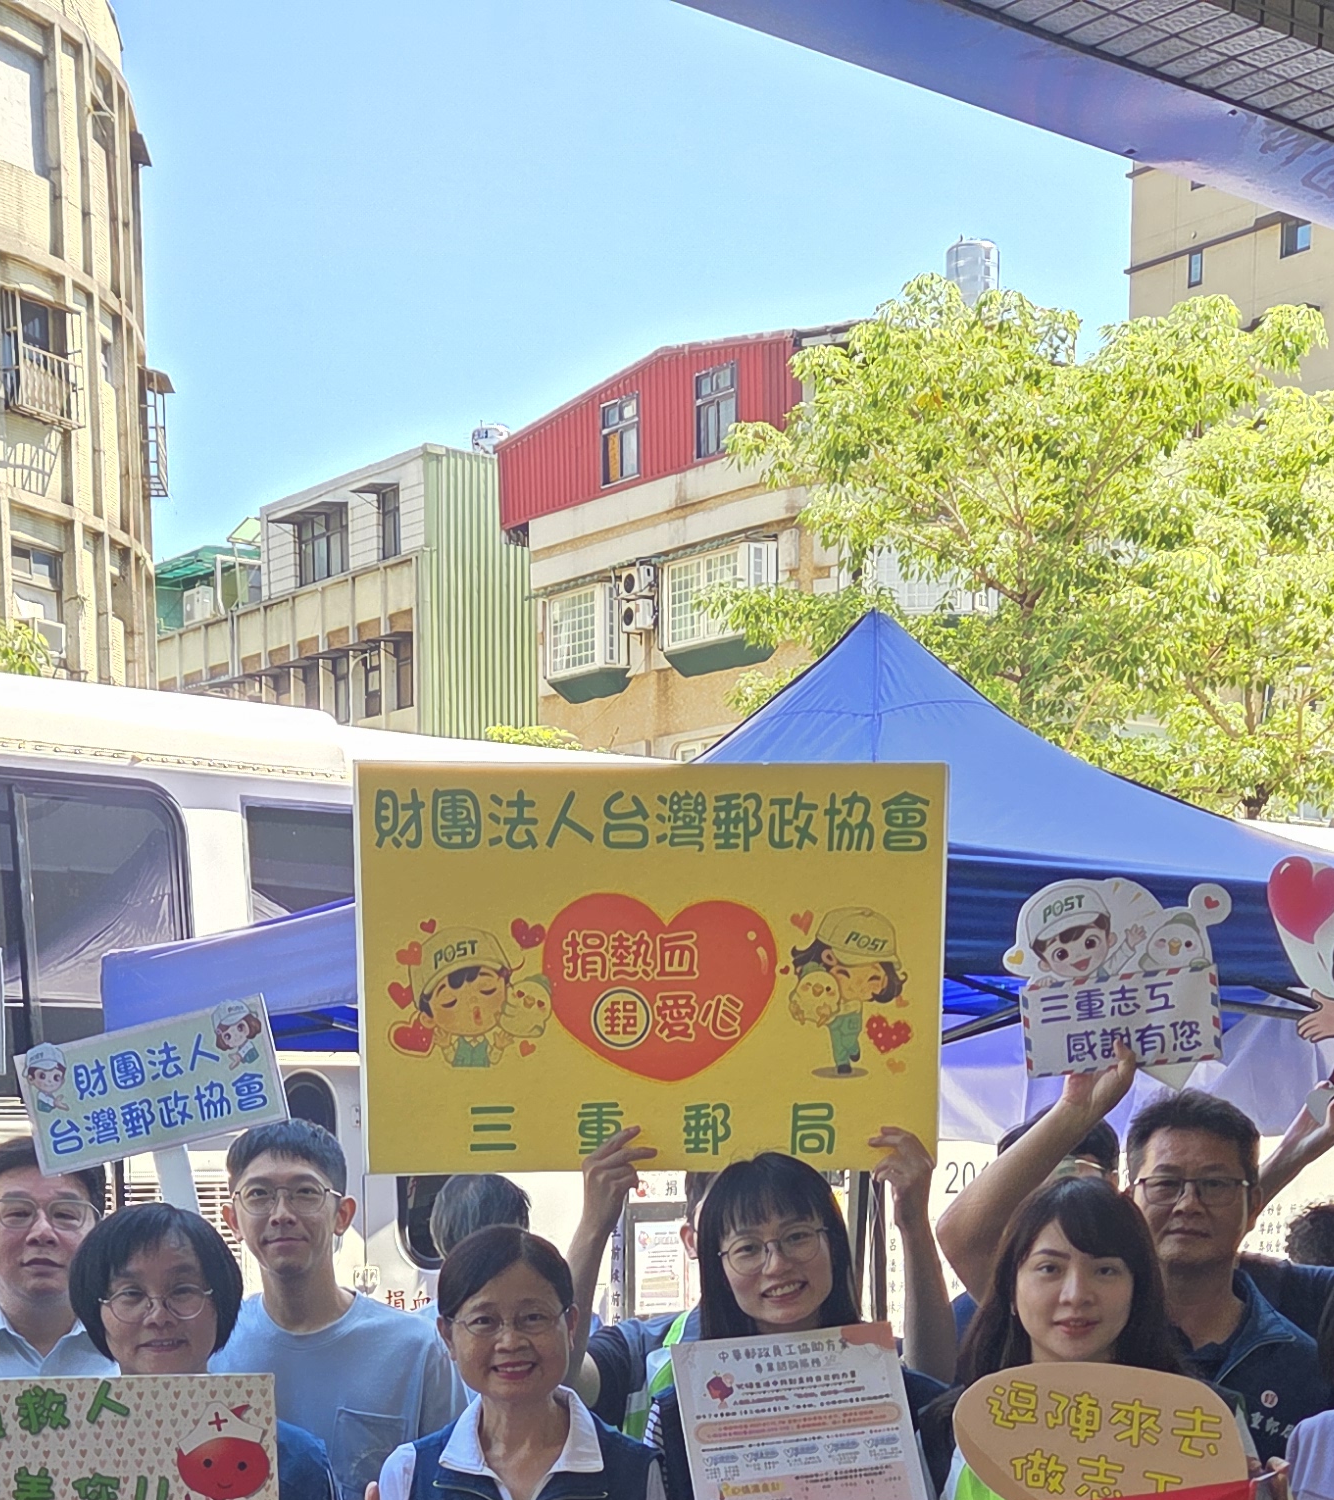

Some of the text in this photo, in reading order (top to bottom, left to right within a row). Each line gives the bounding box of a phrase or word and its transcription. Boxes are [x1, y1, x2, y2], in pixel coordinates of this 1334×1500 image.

[374, 789, 930, 853] 財團法人台灣郵政協會
[1043, 895, 1085, 923] POST
[433, 939, 479, 970] POST
[563, 930, 698, 982] 捐熱血
[845, 931, 889, 953] POST
[73, 1033, 220, 1100] 財團法人
[1067, 1020, 1203, 1063] 感謝有您
[49, 1072, 268, 1155] 台灣郵政協會
[469, 1101, 836, 1157] 三重郵局
[945, 1161, 990, 1193] 20
[987, 1381, 1222, 1457] 逗陣來去
